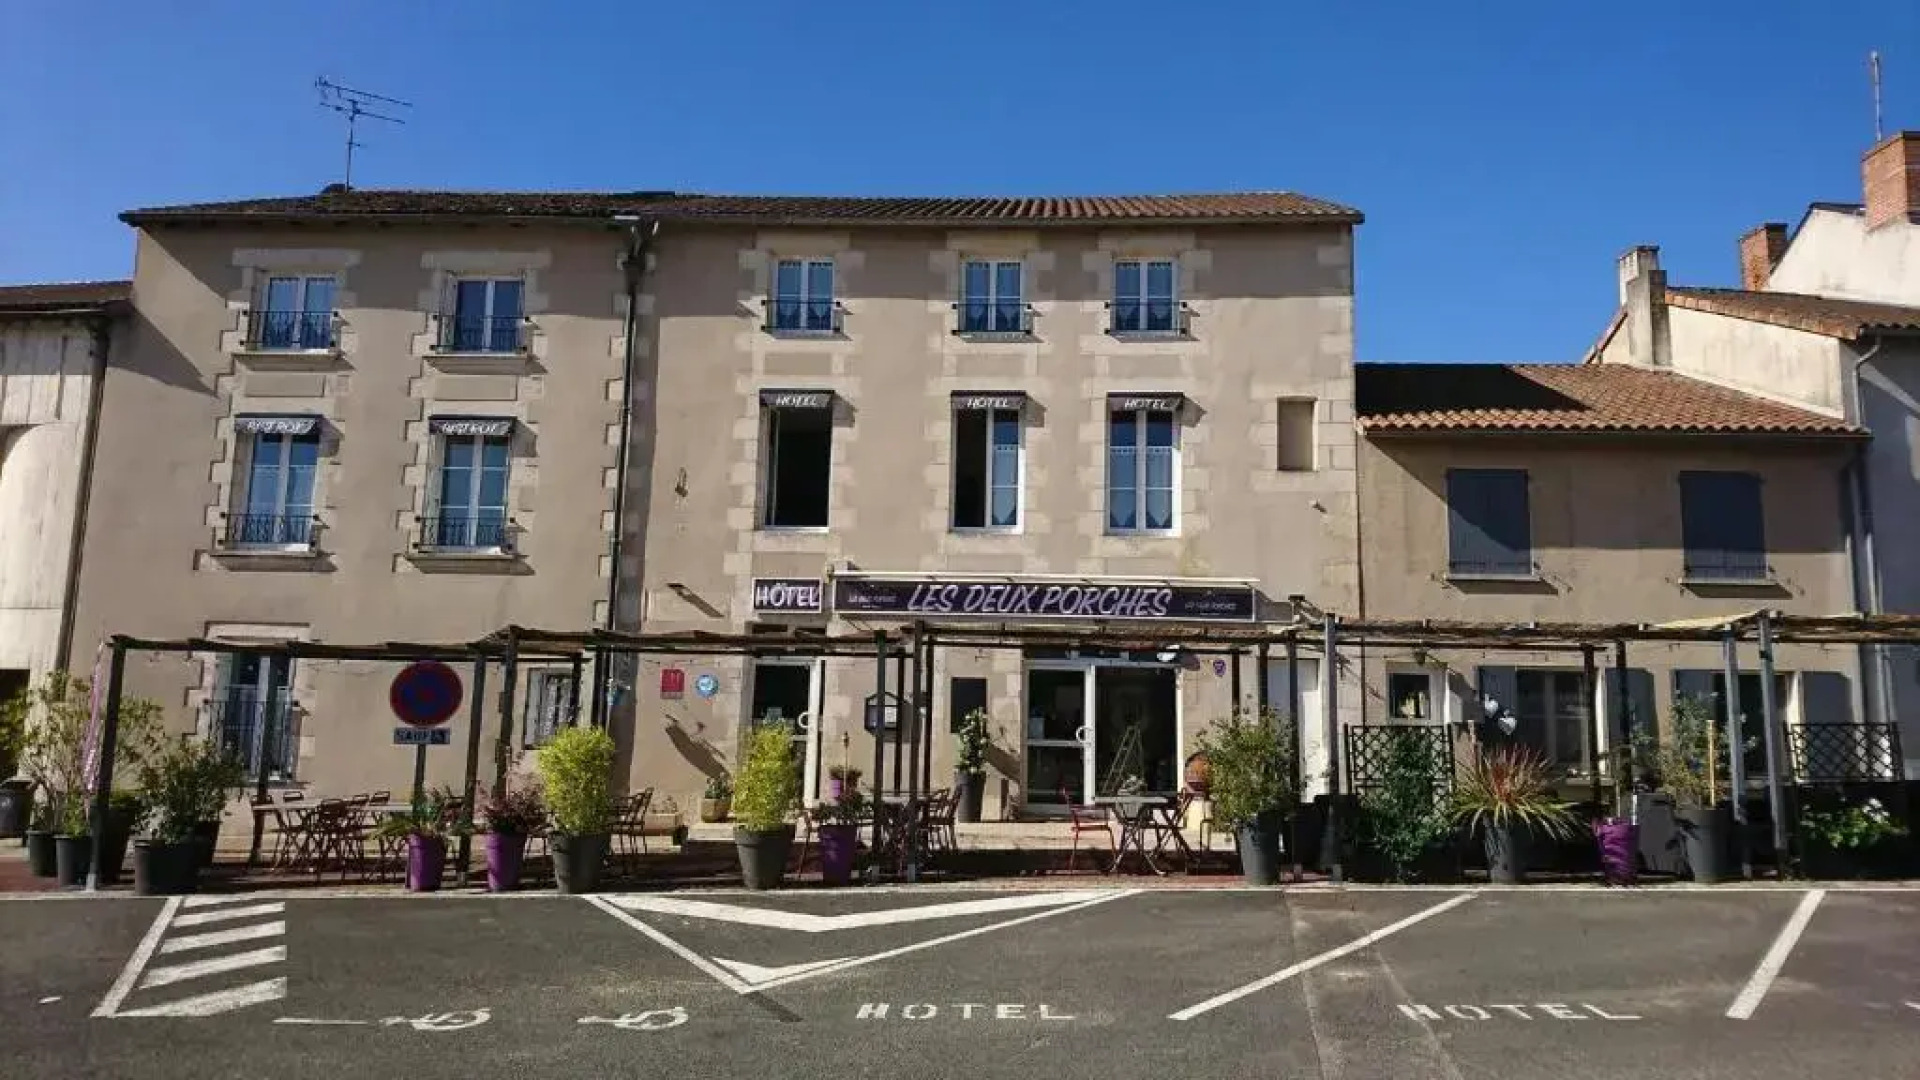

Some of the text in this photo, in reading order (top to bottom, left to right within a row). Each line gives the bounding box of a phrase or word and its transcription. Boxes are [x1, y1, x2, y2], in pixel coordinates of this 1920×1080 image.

[776, 395, 818, 406] HOTEL
[966, 397, 1010, 408] HOTEL
[1124, 398, 1171, 410] HOTEL
[907, 584, 1172, 616] LES DEUX PORCHES
[856, 1003, 1077, 1019] HOTEL
[1397, 1004, 1643, 1020] HOTEL
